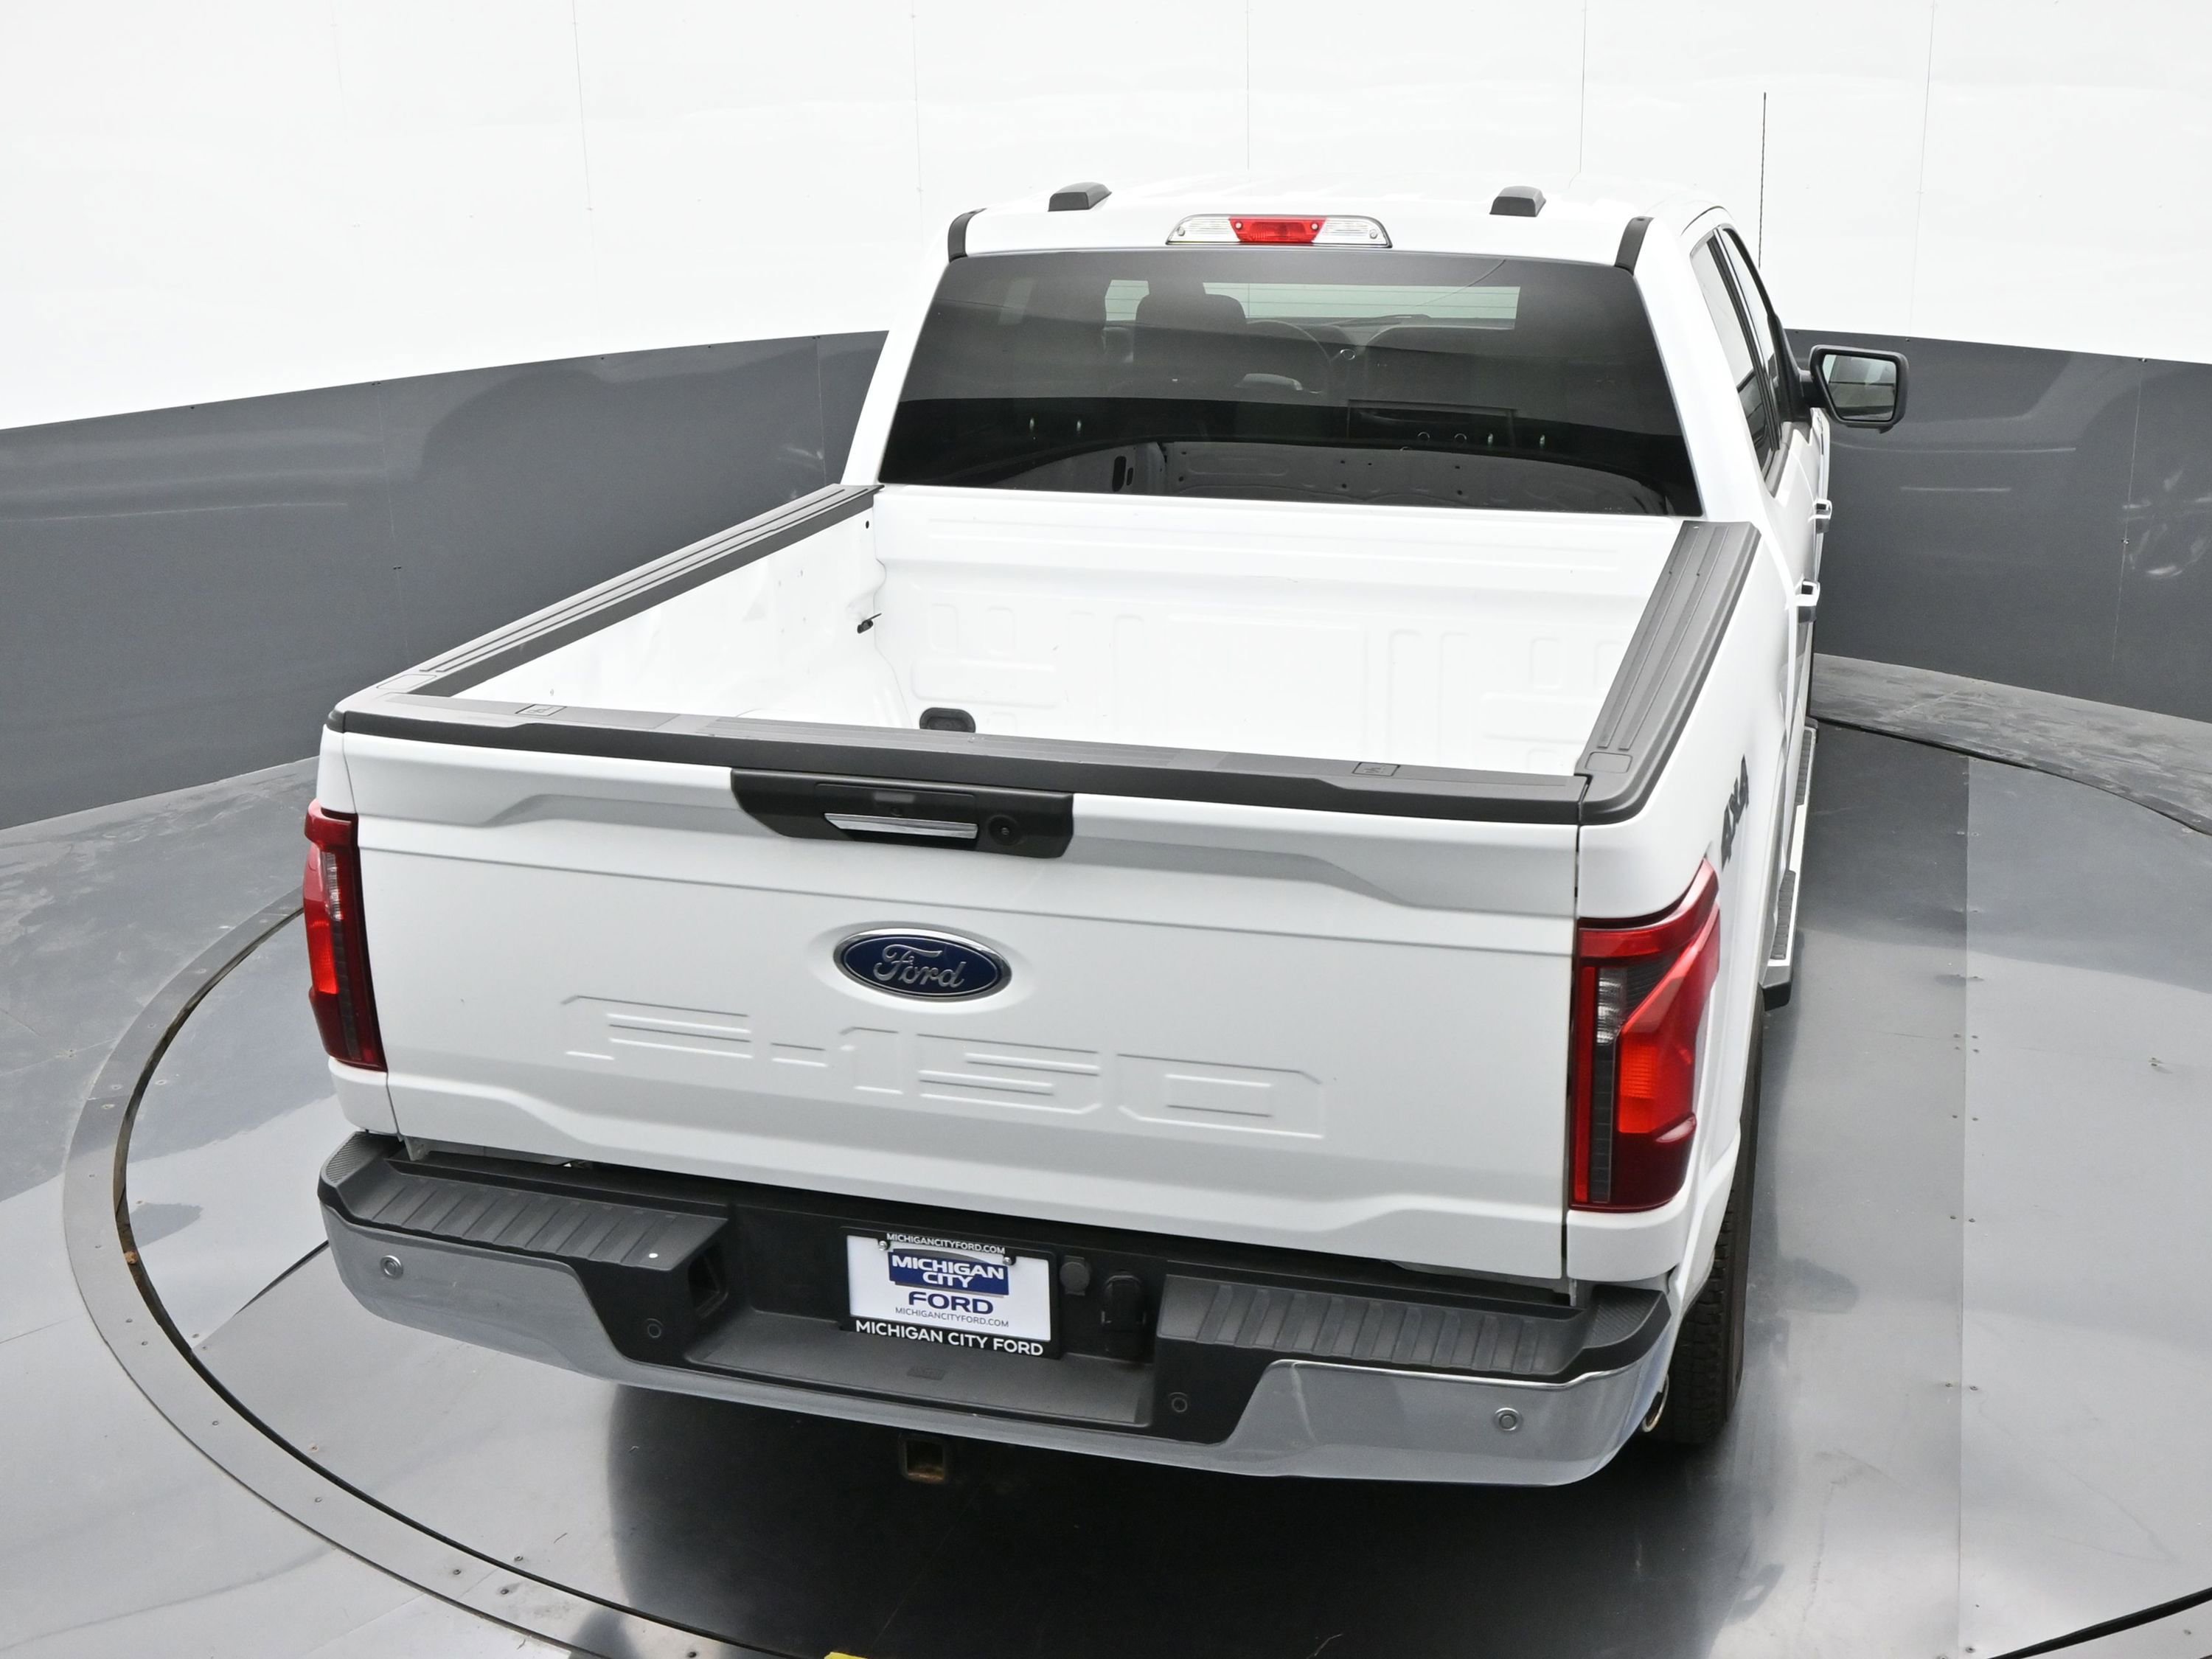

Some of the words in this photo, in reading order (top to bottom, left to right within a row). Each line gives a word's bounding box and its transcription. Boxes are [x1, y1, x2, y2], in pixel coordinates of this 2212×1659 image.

[873, 944, 967, 988] Ford
[562, 995, 1324, 1139] F-150
[886, 1233, 1006, 1254] MICHIGANCITYFORD.COM
[891, 1255, 1004, 1280] MICHIGAN
[922, 1272, 973, 1288] CITY
[908, 1291, 993, 1315] FORD
[895, 1307, 1009, 1327] MICHIGANCITYFORD.COM
[855, 1320, 943, 1343] MICHIGAN
[947, 1332, 988, 1349] CITY
[993, 1338, 1043, 1356] FORD
